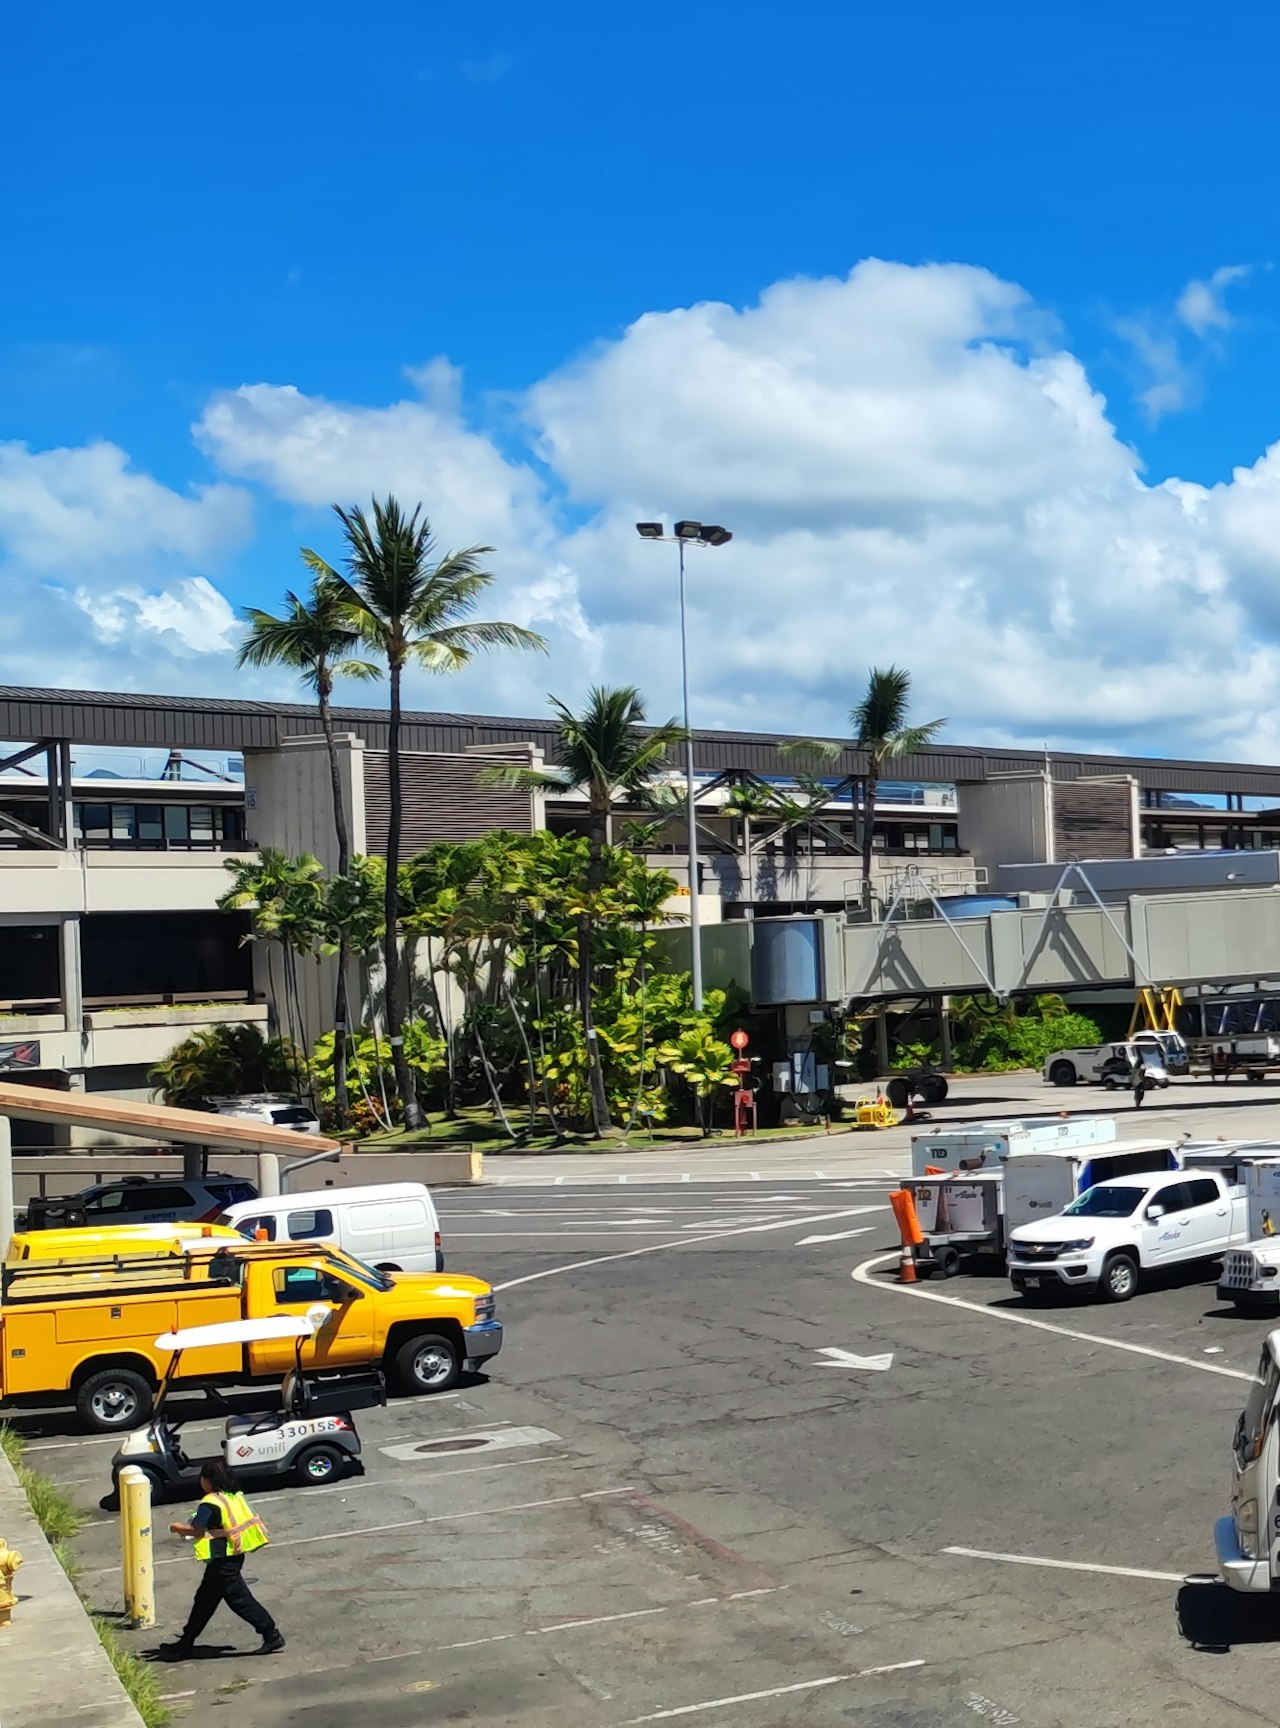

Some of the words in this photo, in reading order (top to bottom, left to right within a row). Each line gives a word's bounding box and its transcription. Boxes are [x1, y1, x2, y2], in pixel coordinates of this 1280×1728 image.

[931, 1148, 948, 1159] TLD
[143, 1211, 177, 1221] AIRPORT
[277, 1419, 336, 1440] 330158
[257, 1441, 286, 1455] unifi
